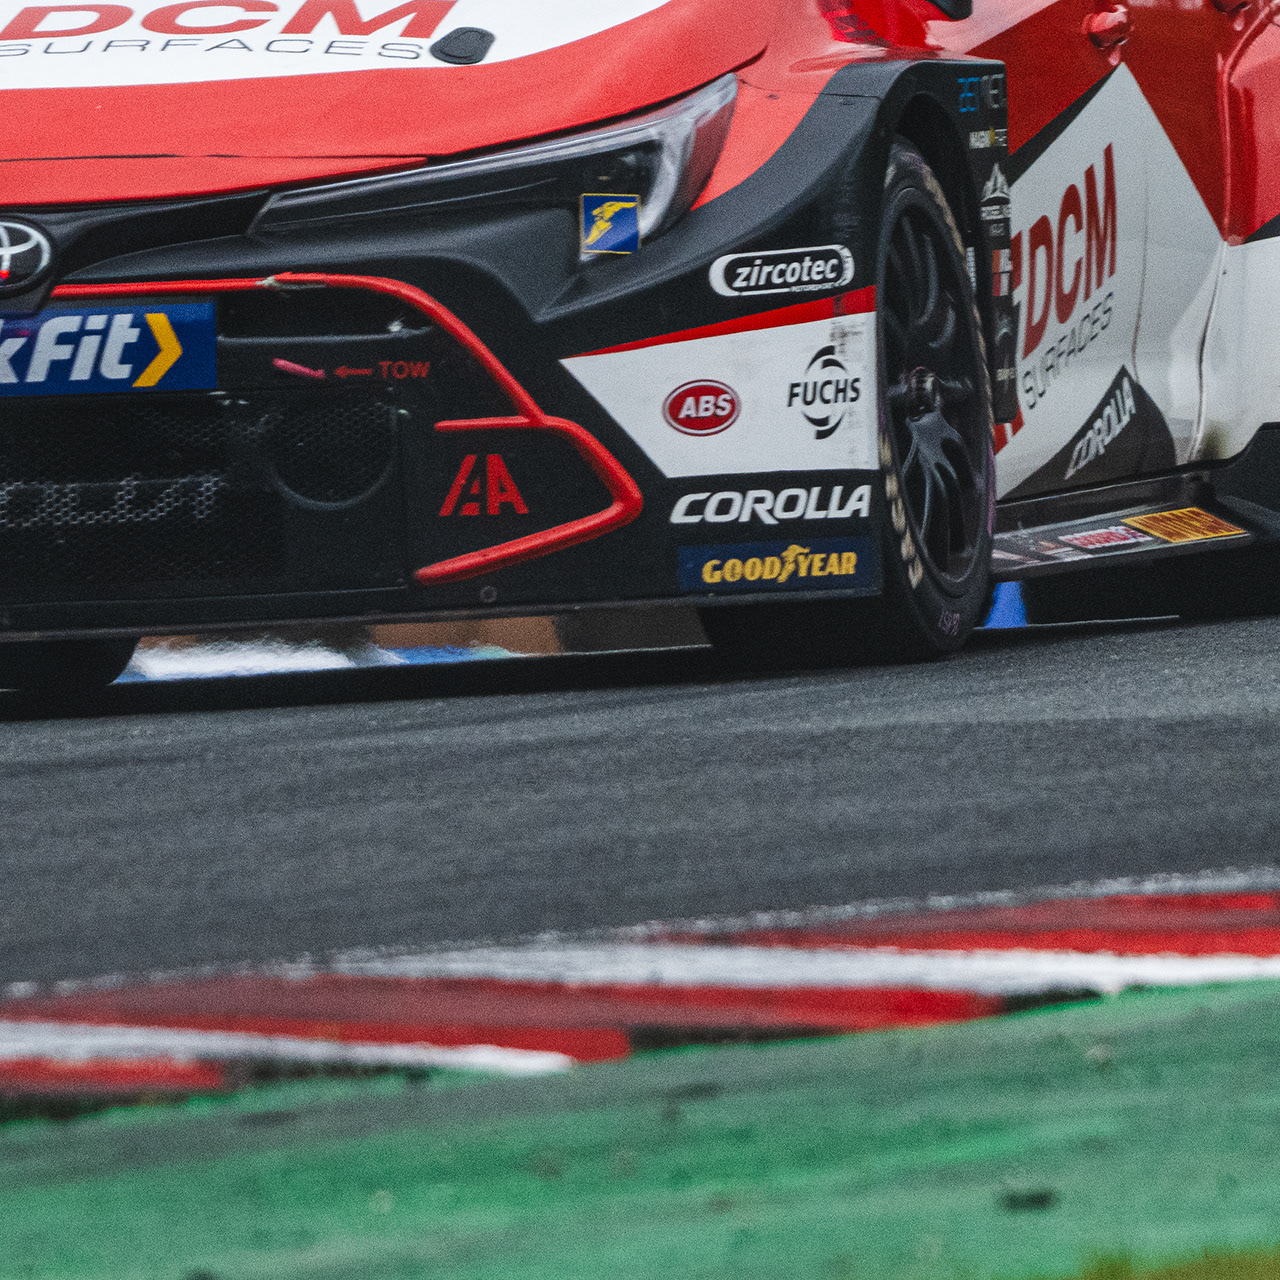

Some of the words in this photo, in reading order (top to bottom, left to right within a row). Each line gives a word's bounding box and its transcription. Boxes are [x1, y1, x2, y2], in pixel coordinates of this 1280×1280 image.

[1022, 141, 1117, 360] DCM
[732, 256, 839, 289] zircotec
[1022, 290, 1113, 410] SURFACES
[378, 359, 430, 379] TOW
[677, 392, 733, 420] ABS
[786, 377, 862, 408] FUCHS
[1064, 375, 1138, 481] COROLLA
[669, 484, 872, 525] COROLLA
